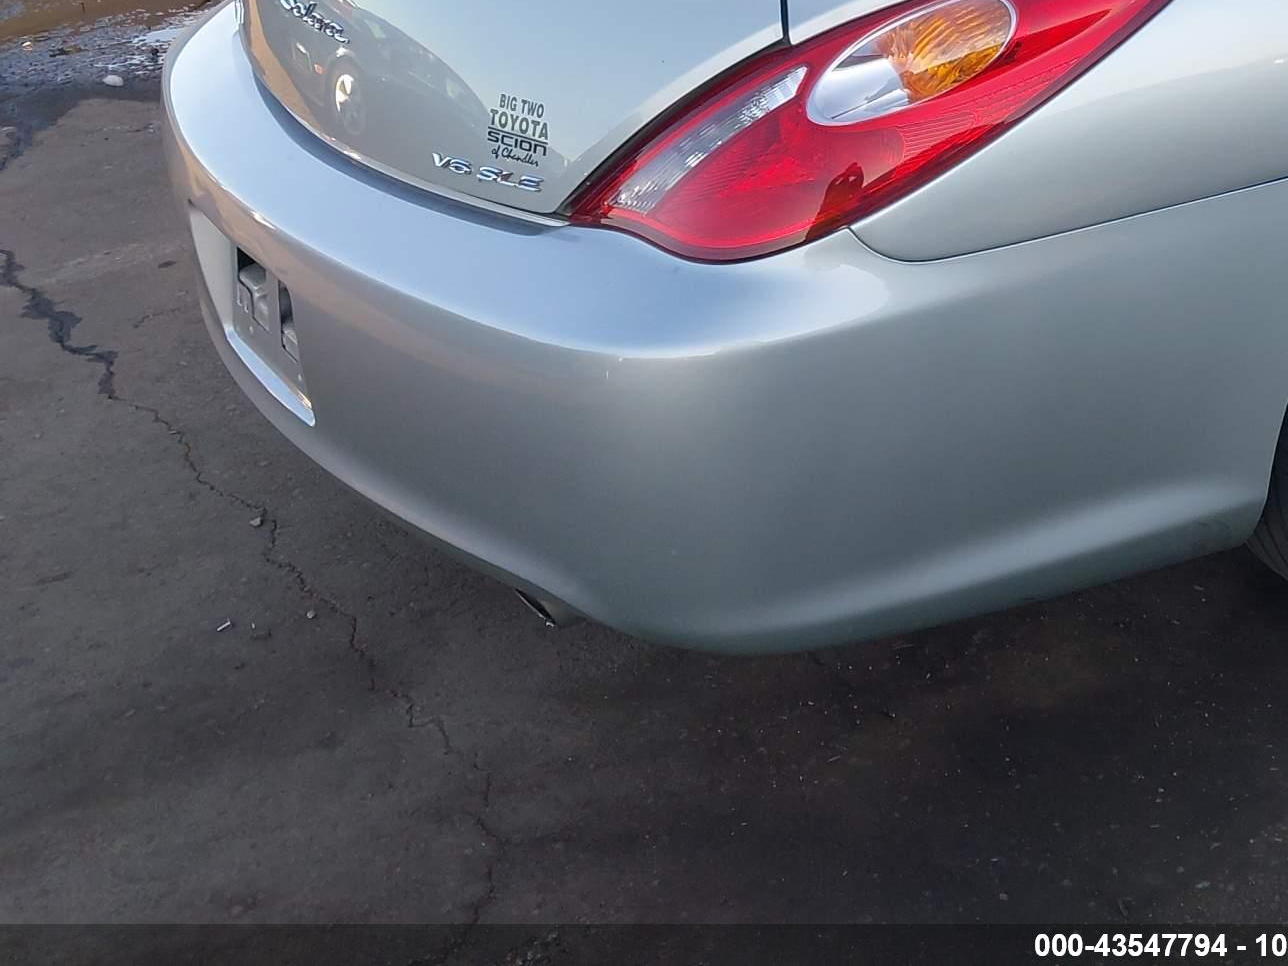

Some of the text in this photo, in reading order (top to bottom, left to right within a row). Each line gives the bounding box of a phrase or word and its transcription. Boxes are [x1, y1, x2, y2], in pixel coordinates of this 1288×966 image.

[499, 93, 545, 119] BIG TWO
[489, 108, 549, 141] TOYOTA
[501, 146, 539, 167] Chandler
[432, 152, 545, 193] V6 SLE
